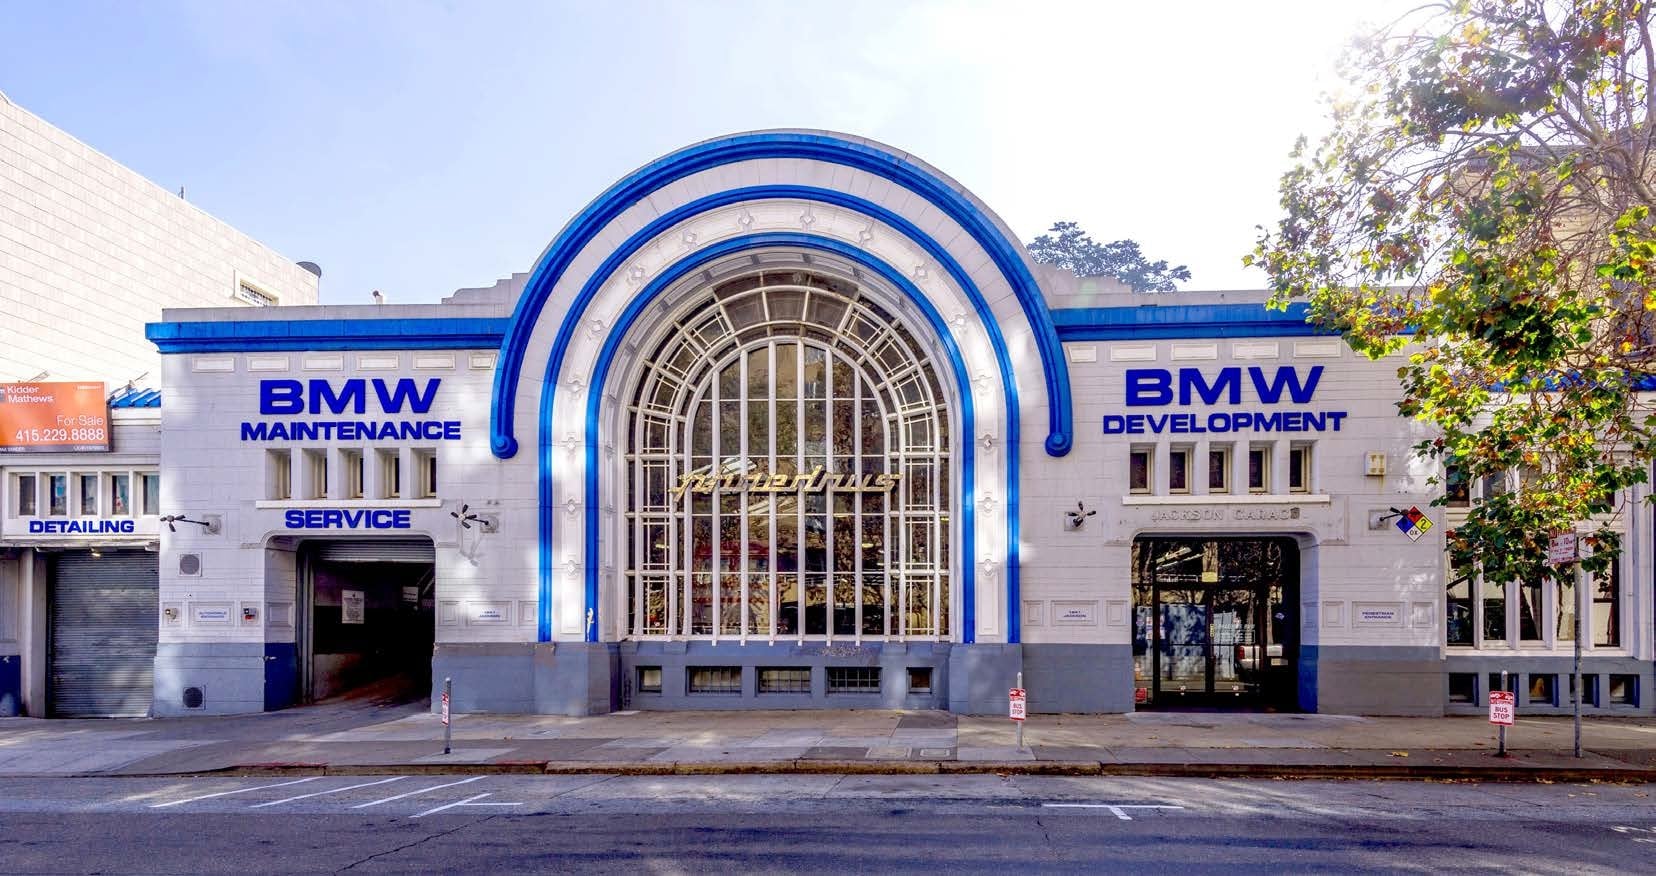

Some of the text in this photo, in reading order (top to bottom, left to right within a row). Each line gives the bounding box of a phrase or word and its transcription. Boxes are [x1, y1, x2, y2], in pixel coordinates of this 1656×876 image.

[7, 385, 39, 394] Kidder
[1125, 366, 1325, 407] BMW
[8, 395, 53, 404] Mathews
[259, 378, 442, 415] BMW
[57, 415, 104, 426] For Sale
[1103, 411, 1348, 434] DEVELOPMENT
[16, 428, 105, 442] 415.229.8888
[241, 421, 462, 441] MAINTENANCE
[285, 510, 411, 529] SERVICE
[1151, 507, 1300, 522] JACKSON GARAG
[29, 520, 135, 534] DETAILING
[1420, 518, 1427, 530] 2
